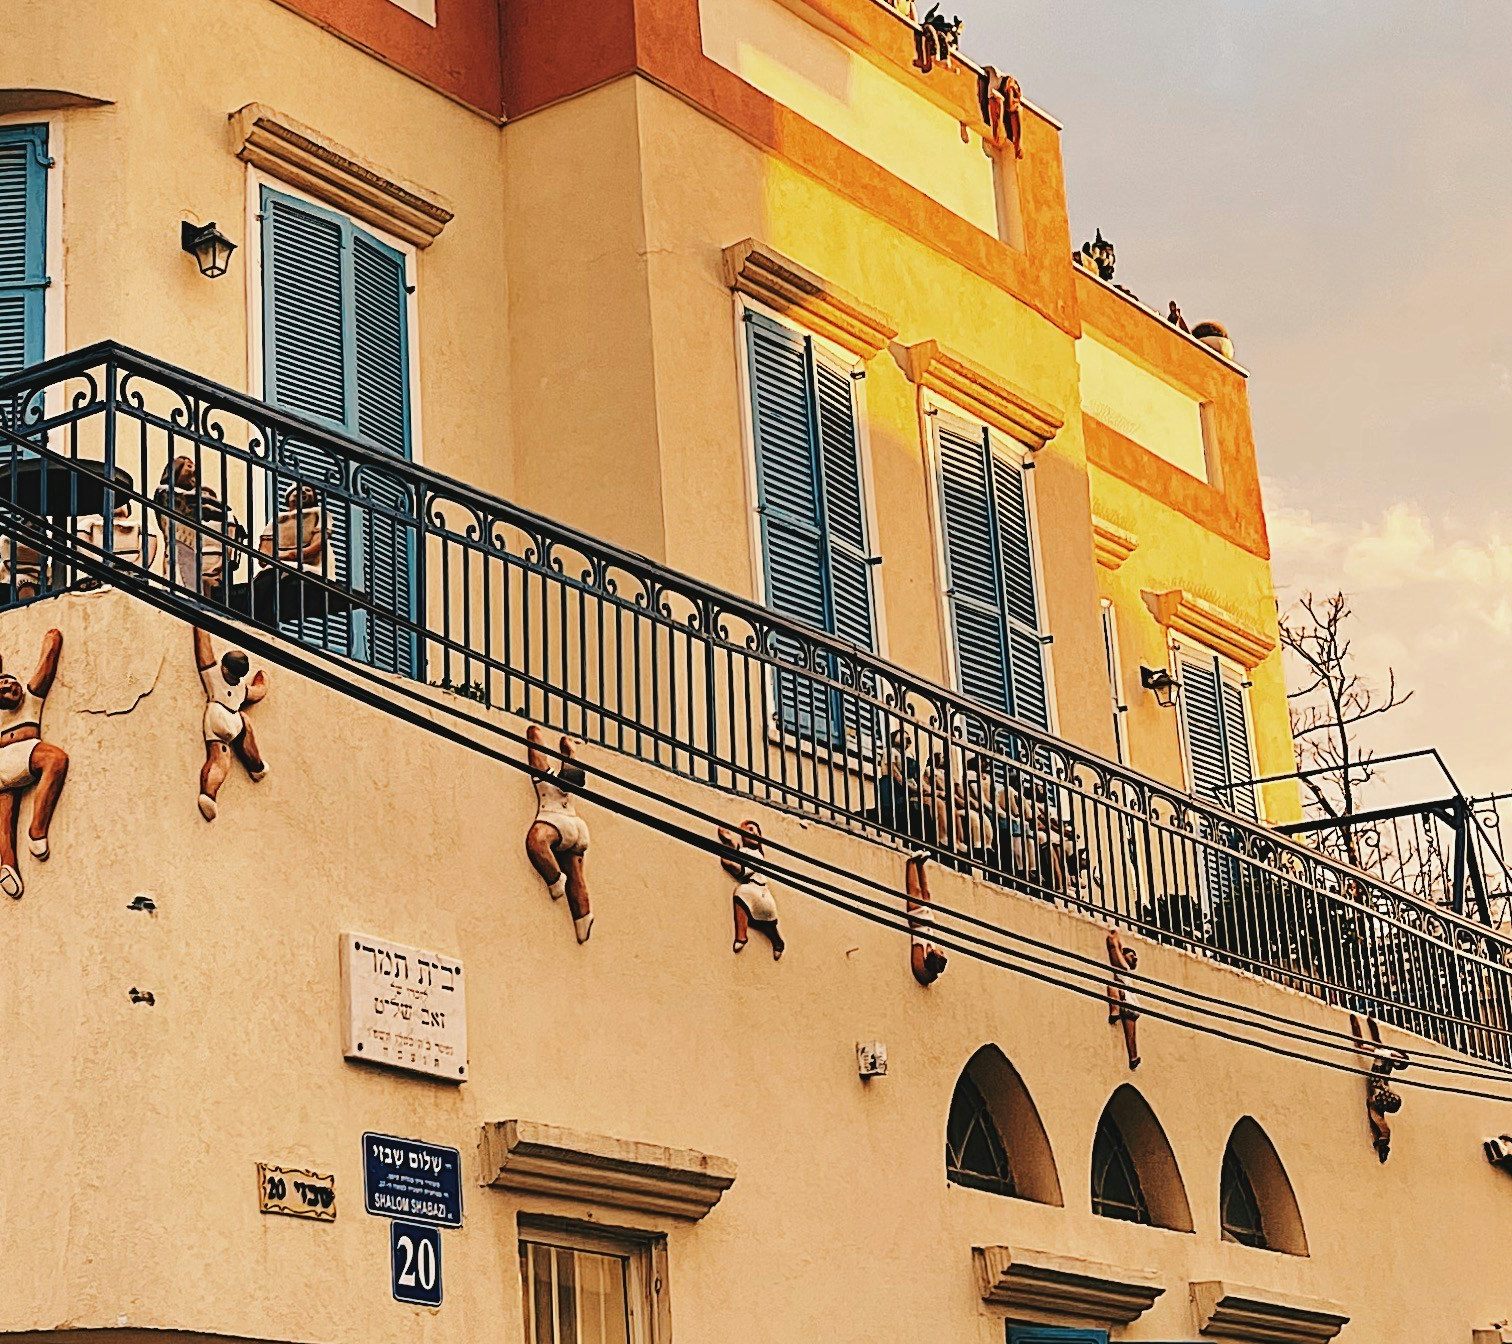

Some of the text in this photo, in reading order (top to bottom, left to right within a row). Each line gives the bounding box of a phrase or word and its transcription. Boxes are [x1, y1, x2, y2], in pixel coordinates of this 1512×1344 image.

[267, 1176, 287, 1200] 20
[374, 1192, 410, 1212] SHALOM
[411, 1199, 446, 1218] SHABAZI
[396, 1234, 436, 1290] 20
